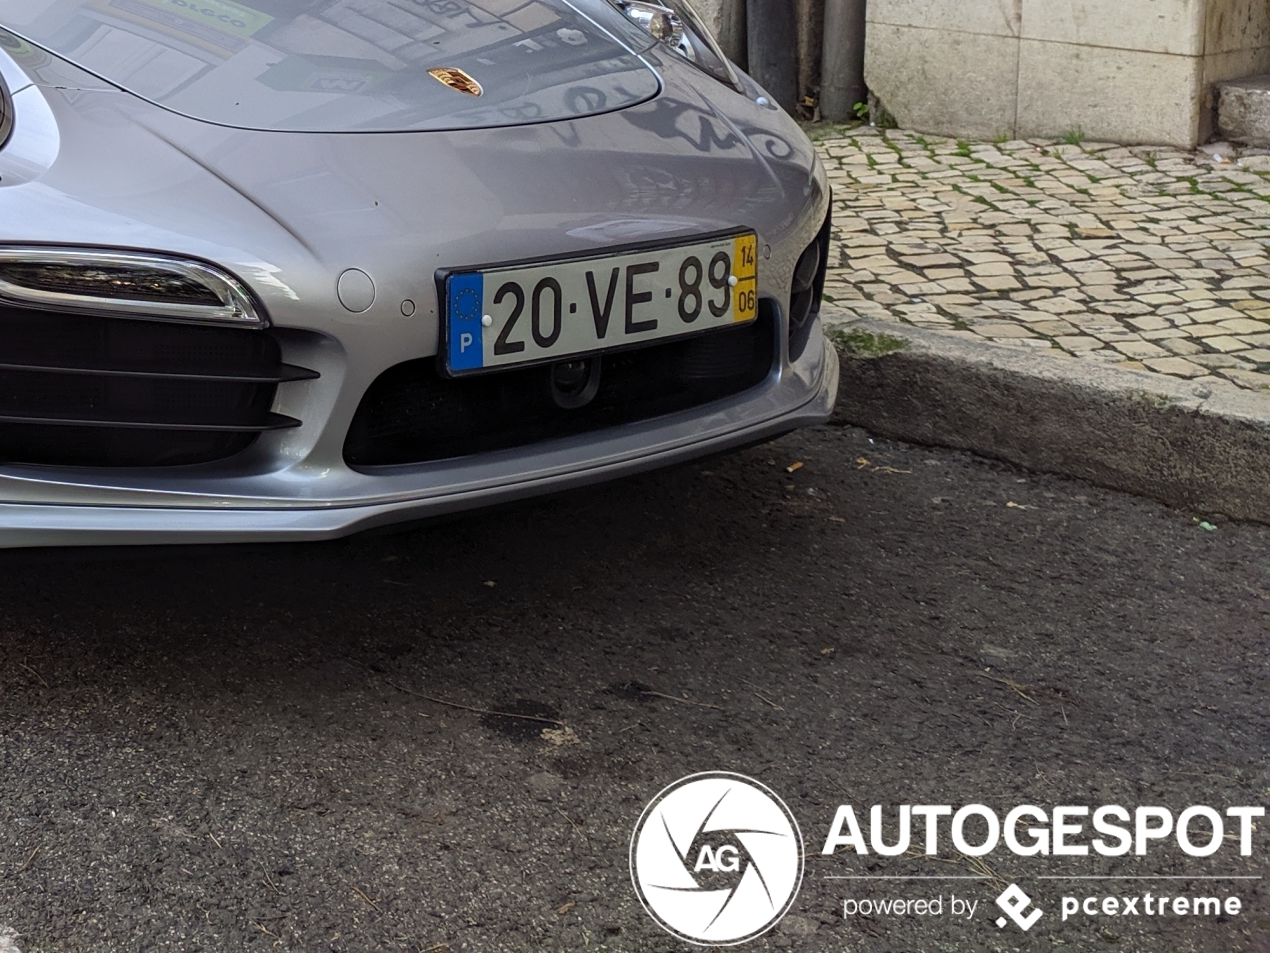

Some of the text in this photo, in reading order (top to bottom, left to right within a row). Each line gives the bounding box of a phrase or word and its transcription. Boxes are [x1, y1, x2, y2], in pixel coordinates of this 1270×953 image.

[741, 244, 754, 267] 14
[738, 289, 756, 313] 06
[460, 332, 473, 353] P
